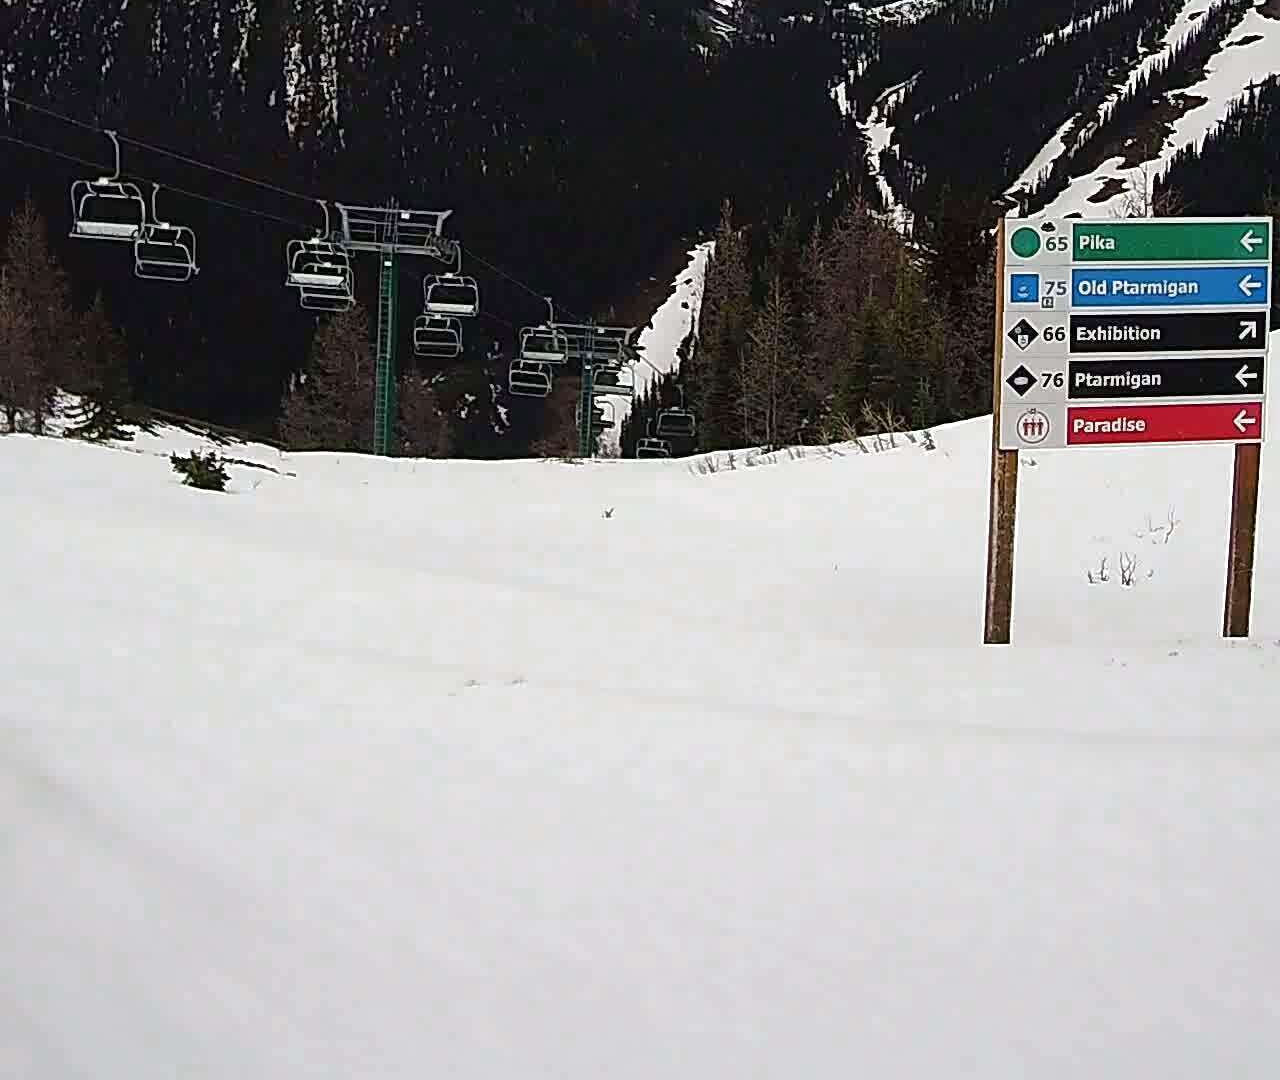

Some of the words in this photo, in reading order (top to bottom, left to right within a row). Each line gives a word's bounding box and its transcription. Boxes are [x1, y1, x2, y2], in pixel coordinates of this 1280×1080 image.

[1045, 236, 1069, 252] 65
[1078, 235, 1116, 250] Pika
[1044, 281, 1068, 296] 75
[1078, 279, 1107, 295] Old
[1112, 279, 1199, 299] Ptarmigan
[1043, 326, 1066, 341] 66
[1076, 325, 1161, 341] Exhibition
[1041, 373, 1064, 387] 76
[1075, 371, 1162, 389] Ptarmigan
[1073, 418, 1146, 432] Paradise
